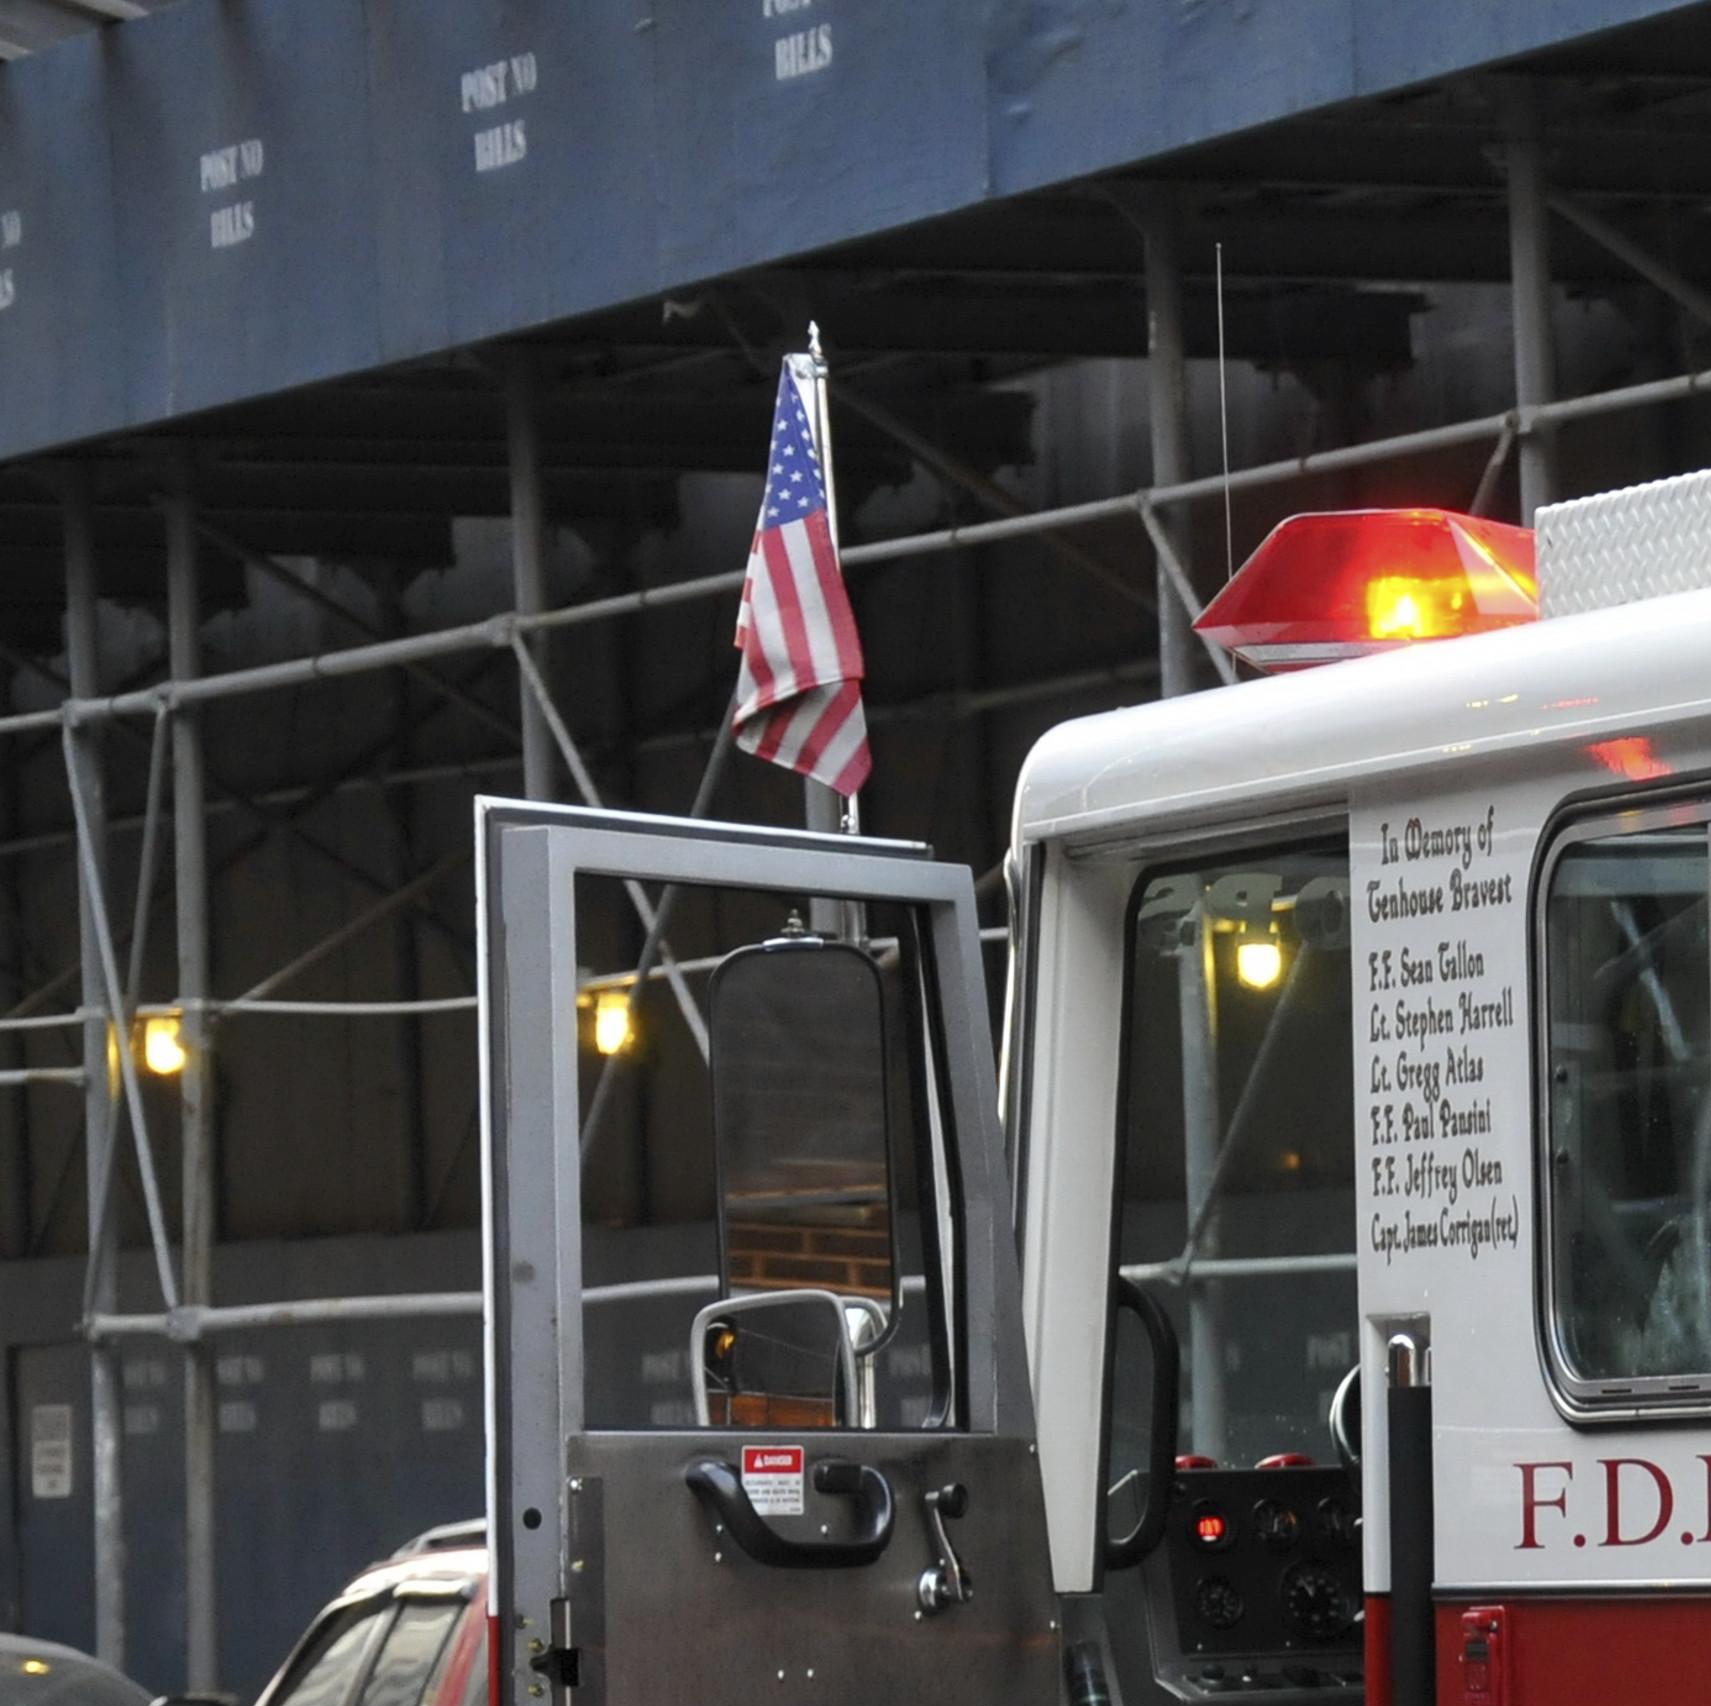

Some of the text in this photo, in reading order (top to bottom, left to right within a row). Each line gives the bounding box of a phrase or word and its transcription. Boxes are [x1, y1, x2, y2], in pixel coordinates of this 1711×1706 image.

[1381, 805, 1494, 870] In Memory of
[1366, 868, 1512, 923] Tenhouse Bravest
[1368, 940, 1484, 992] F.F. Sean Tallon
[1369, 986, 1514, 1052] Lt. Stephen Harrell
[1370, 1044, 1483, 1102] Lt. Gregg Atlas
[1370, 1097, 1492, 1146] F.F. Paul Pansini
[1371, 1147, 1503, 1206] F.F. Jeffrey Olsen
[1403, 1209, 1438, 1253] James
